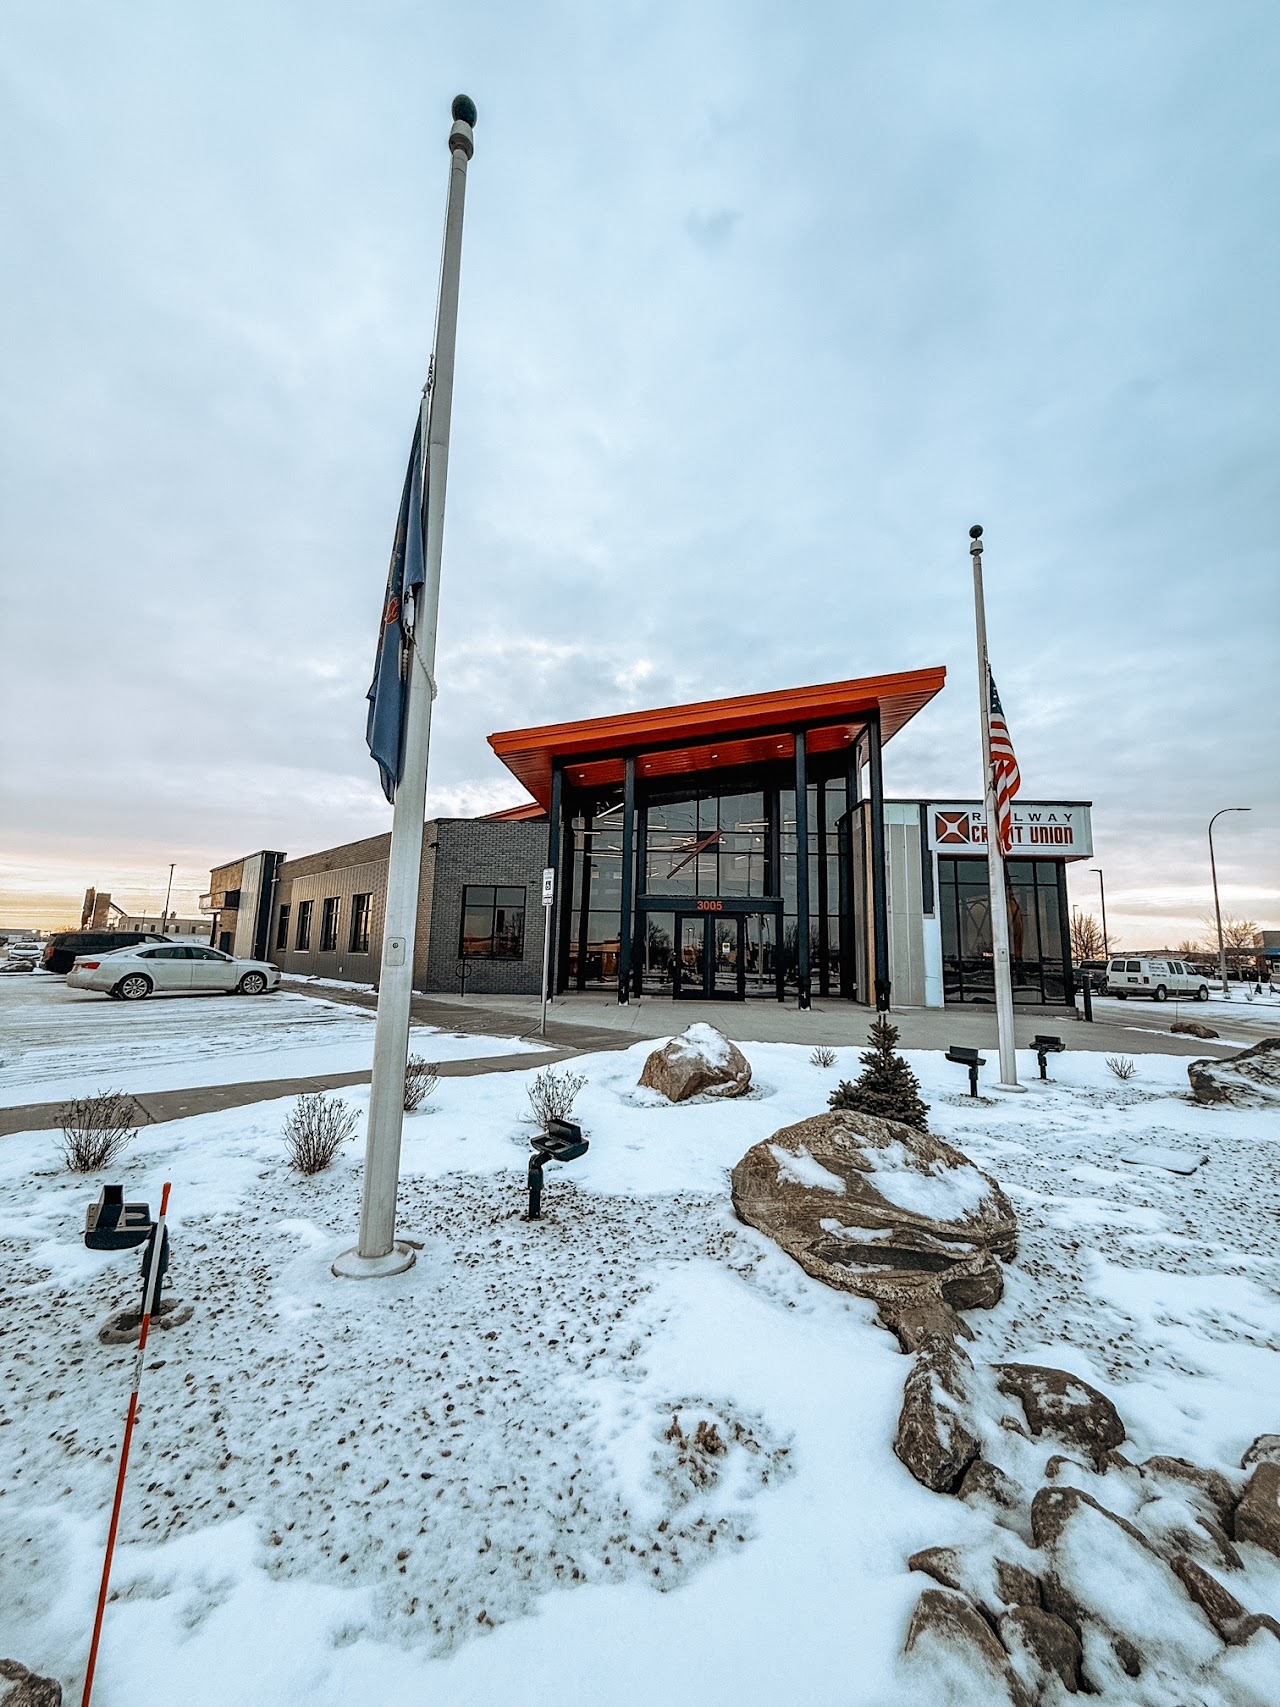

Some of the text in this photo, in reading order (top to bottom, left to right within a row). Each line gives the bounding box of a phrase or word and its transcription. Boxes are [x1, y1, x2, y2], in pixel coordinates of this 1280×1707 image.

[972, 812, 1073, 822] RLWAY
[971, 825, 1074, 844] CRIT UNION
[697, 900, 723, 910] 3005
